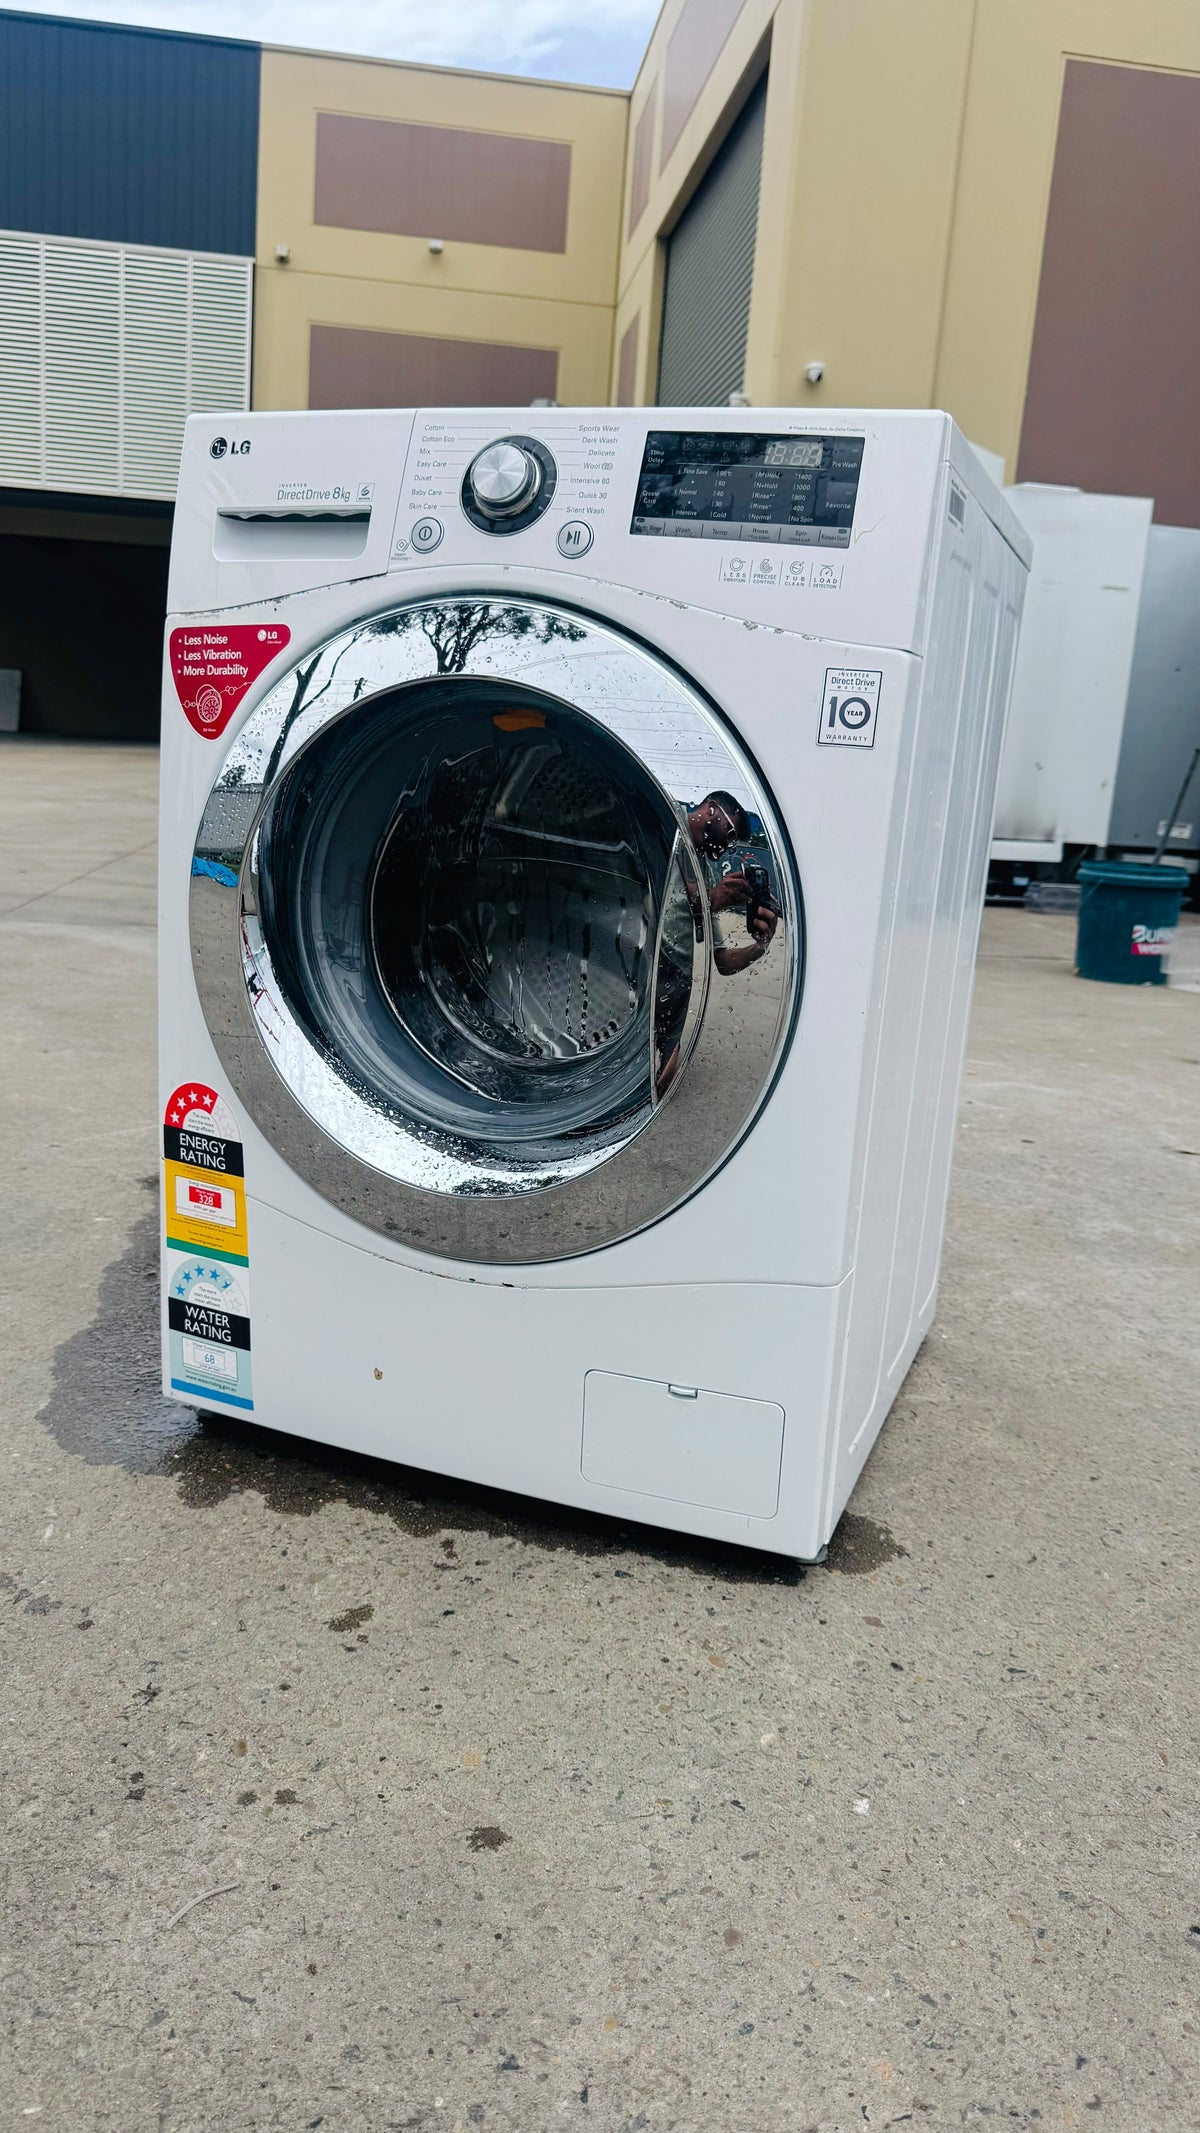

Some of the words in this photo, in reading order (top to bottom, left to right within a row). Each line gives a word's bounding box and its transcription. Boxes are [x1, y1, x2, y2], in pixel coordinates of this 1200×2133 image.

[578, 424, 600, 432] Sports
[602, 424, 621, 432] Wear
[582, 436, 597, 444] Dark
[230, 440, 252, 455] LG
[588, 449, 616, 457] Delicate
[417, 460, 431, 468] Easy
[647, 456, 664, 464] Delay
[583, 462, 600, 470] Wool
[570, 476, 600, 484] Intensive
[601, 477, 610, 485] 60
[411, 489, 427, 497] Baby
[578, 491, 598, 499] Quick
[408, 502, 422, 510] Skin
[423, 502, 438, 510] Care
[566, 505, 585, 514] Silent
[586, 506, 605, 515] Wash
[825, 501, 851, 510] Favorite
[675, 509, 697, 517] Intensive
[712, 528, 728, 536] Temp
[794, 529, 808, 537] Spin
[184, 634, 202, 646] Less
[203, 633, 228, 645] Noise
[267, 631, 278, 640] LG
[183, 650, 201, 661] Less
[203, 649, 242, 660] Vibration
[183, 665, 206, 677] More
[207, 663, 249, 678] Durability
[831, 676, 854, 685] Direct
[855, 678, 876, 686] Drive
[828, 696, 872, 730] 10
[825, 734, 868, 742] WARRANTY
[179, 1132, 227, 1155] ENERGY
[180, 1147, 226, 1170] RATING
[198, 1194, 214, 1206] 328
[185, 1304, 231, 1328] WATER
[184, 1318, 232, 1343] RATING
[204, 1353, 215, 1364] 68
